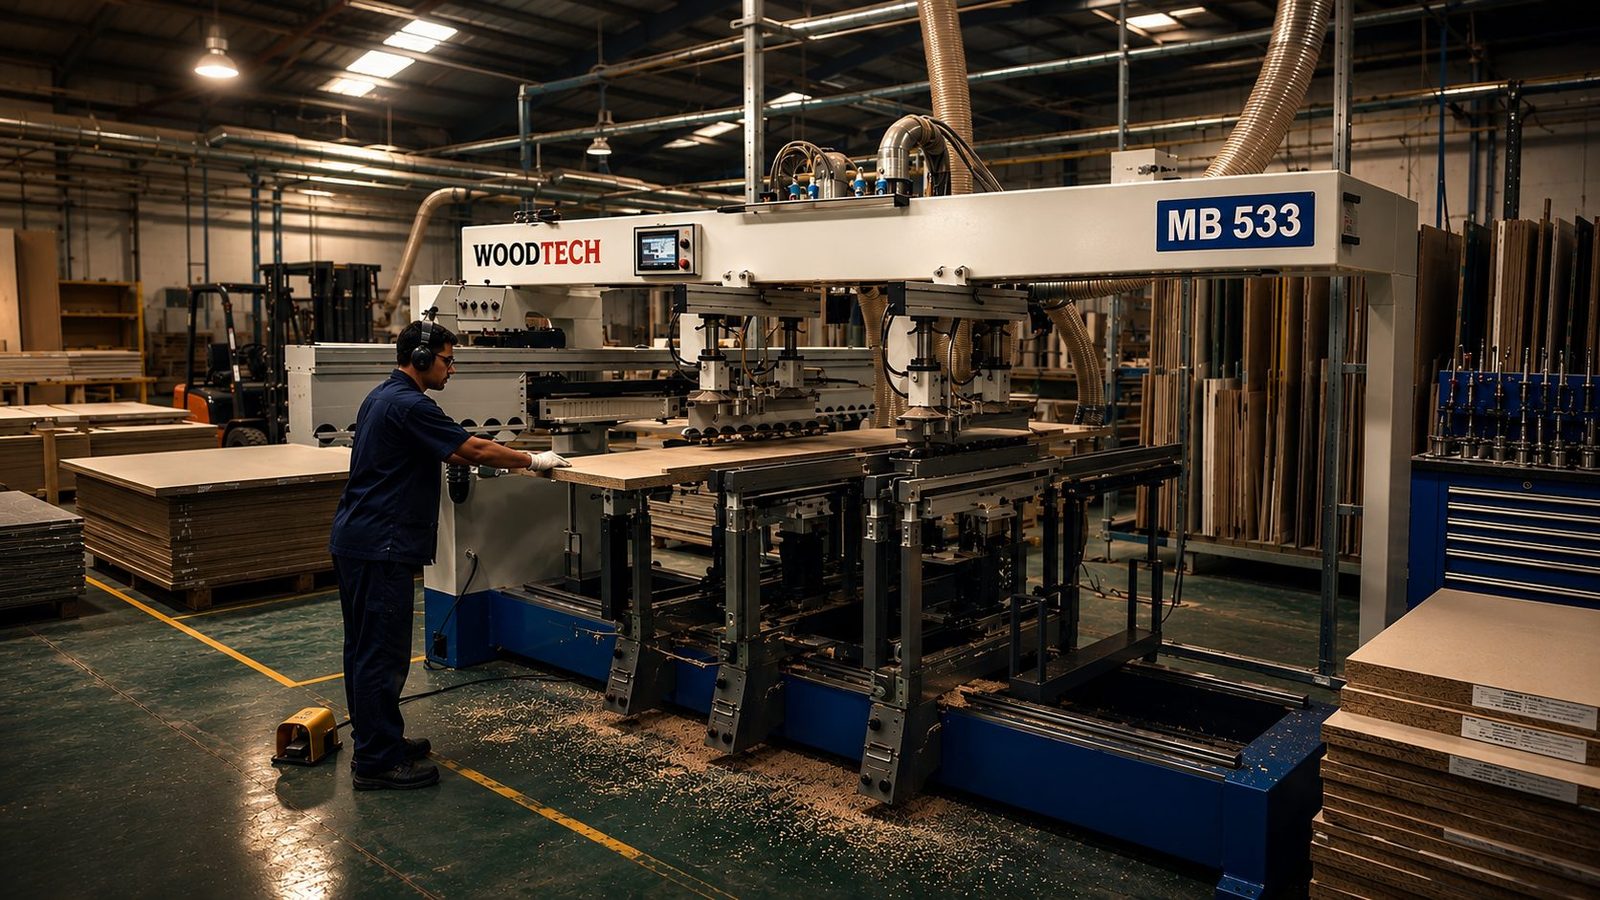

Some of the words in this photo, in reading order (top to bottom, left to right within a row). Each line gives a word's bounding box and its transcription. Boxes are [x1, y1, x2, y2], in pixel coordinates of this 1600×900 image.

[1168, 207, 1222, 242] MB
[1233, 203, 1301, 239] 533
[473, 239, 601, 267] WOODTECH
